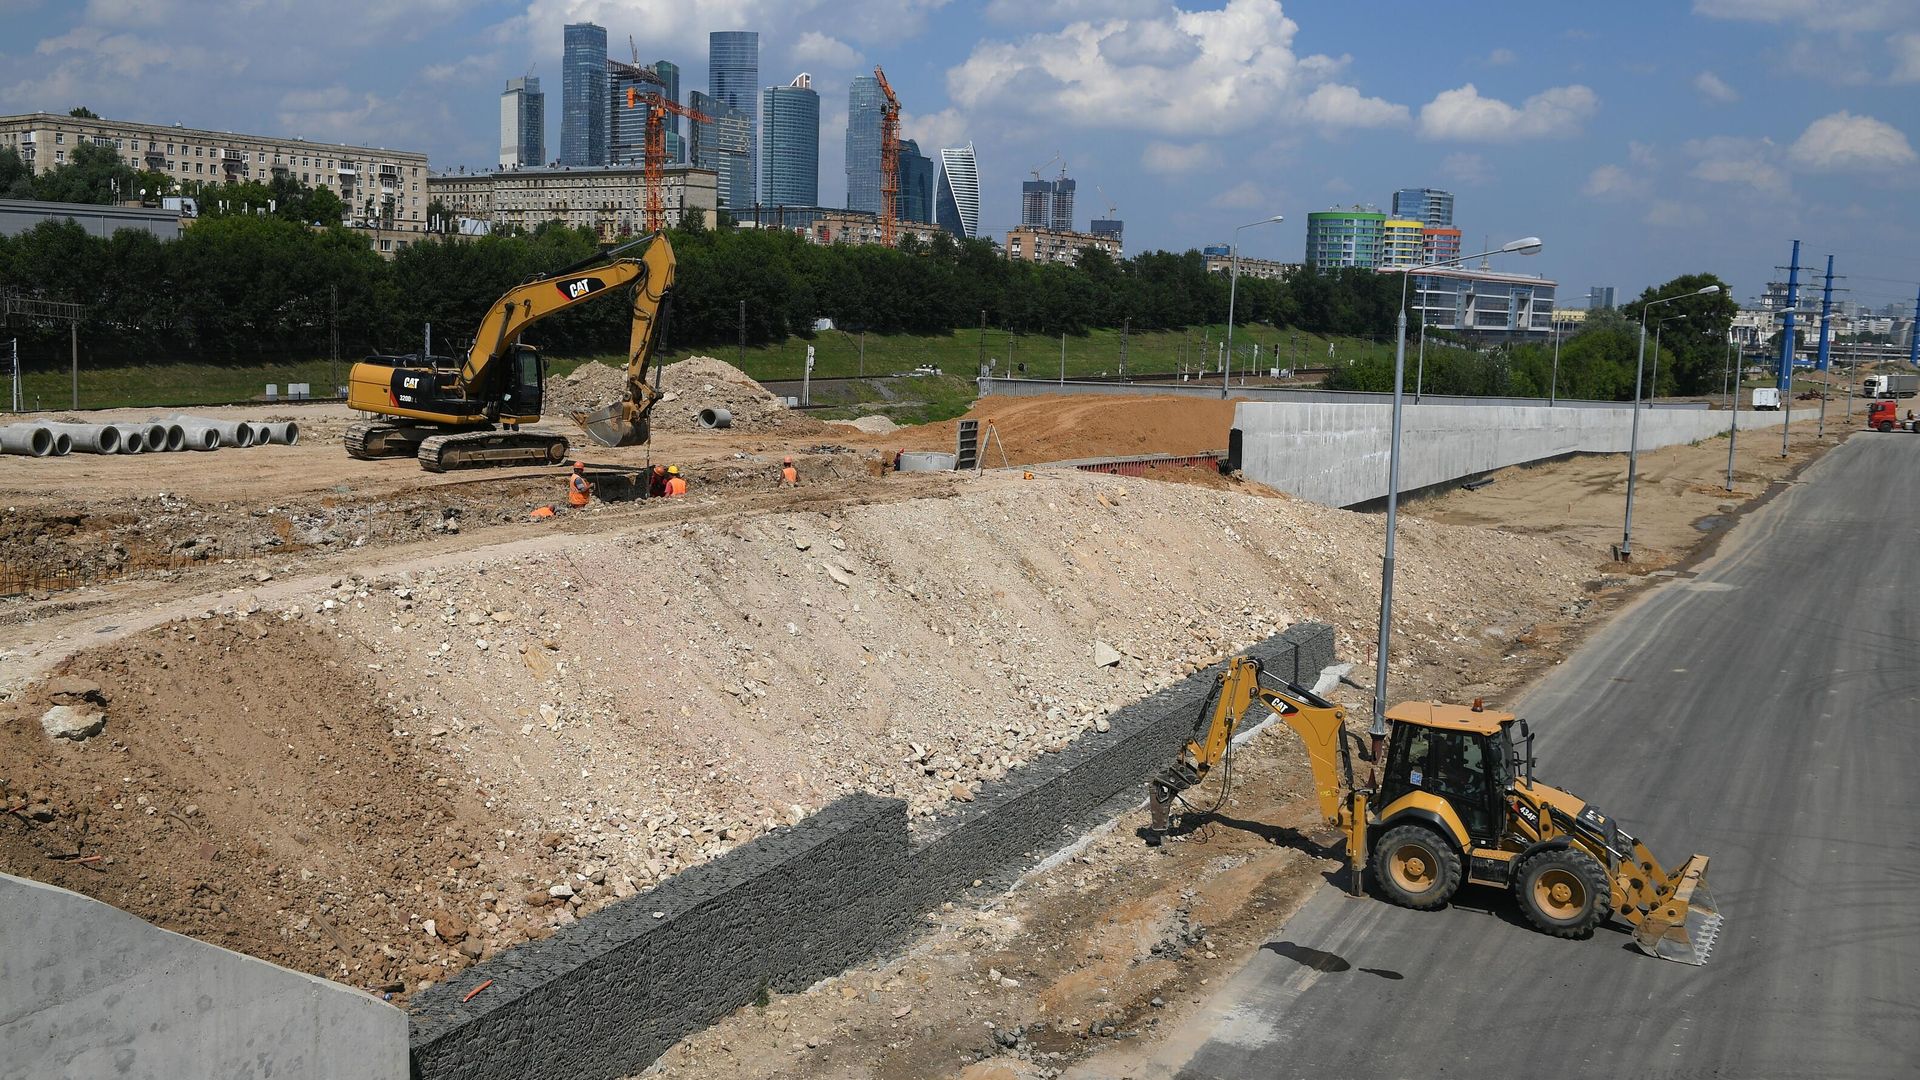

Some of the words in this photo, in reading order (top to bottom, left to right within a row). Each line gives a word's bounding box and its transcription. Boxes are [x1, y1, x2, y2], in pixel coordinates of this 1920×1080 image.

[570, 279, 589, 298] CAT
[404, 377, 419, 389] CAT
[1271, 697, 1288, 713] CAT
